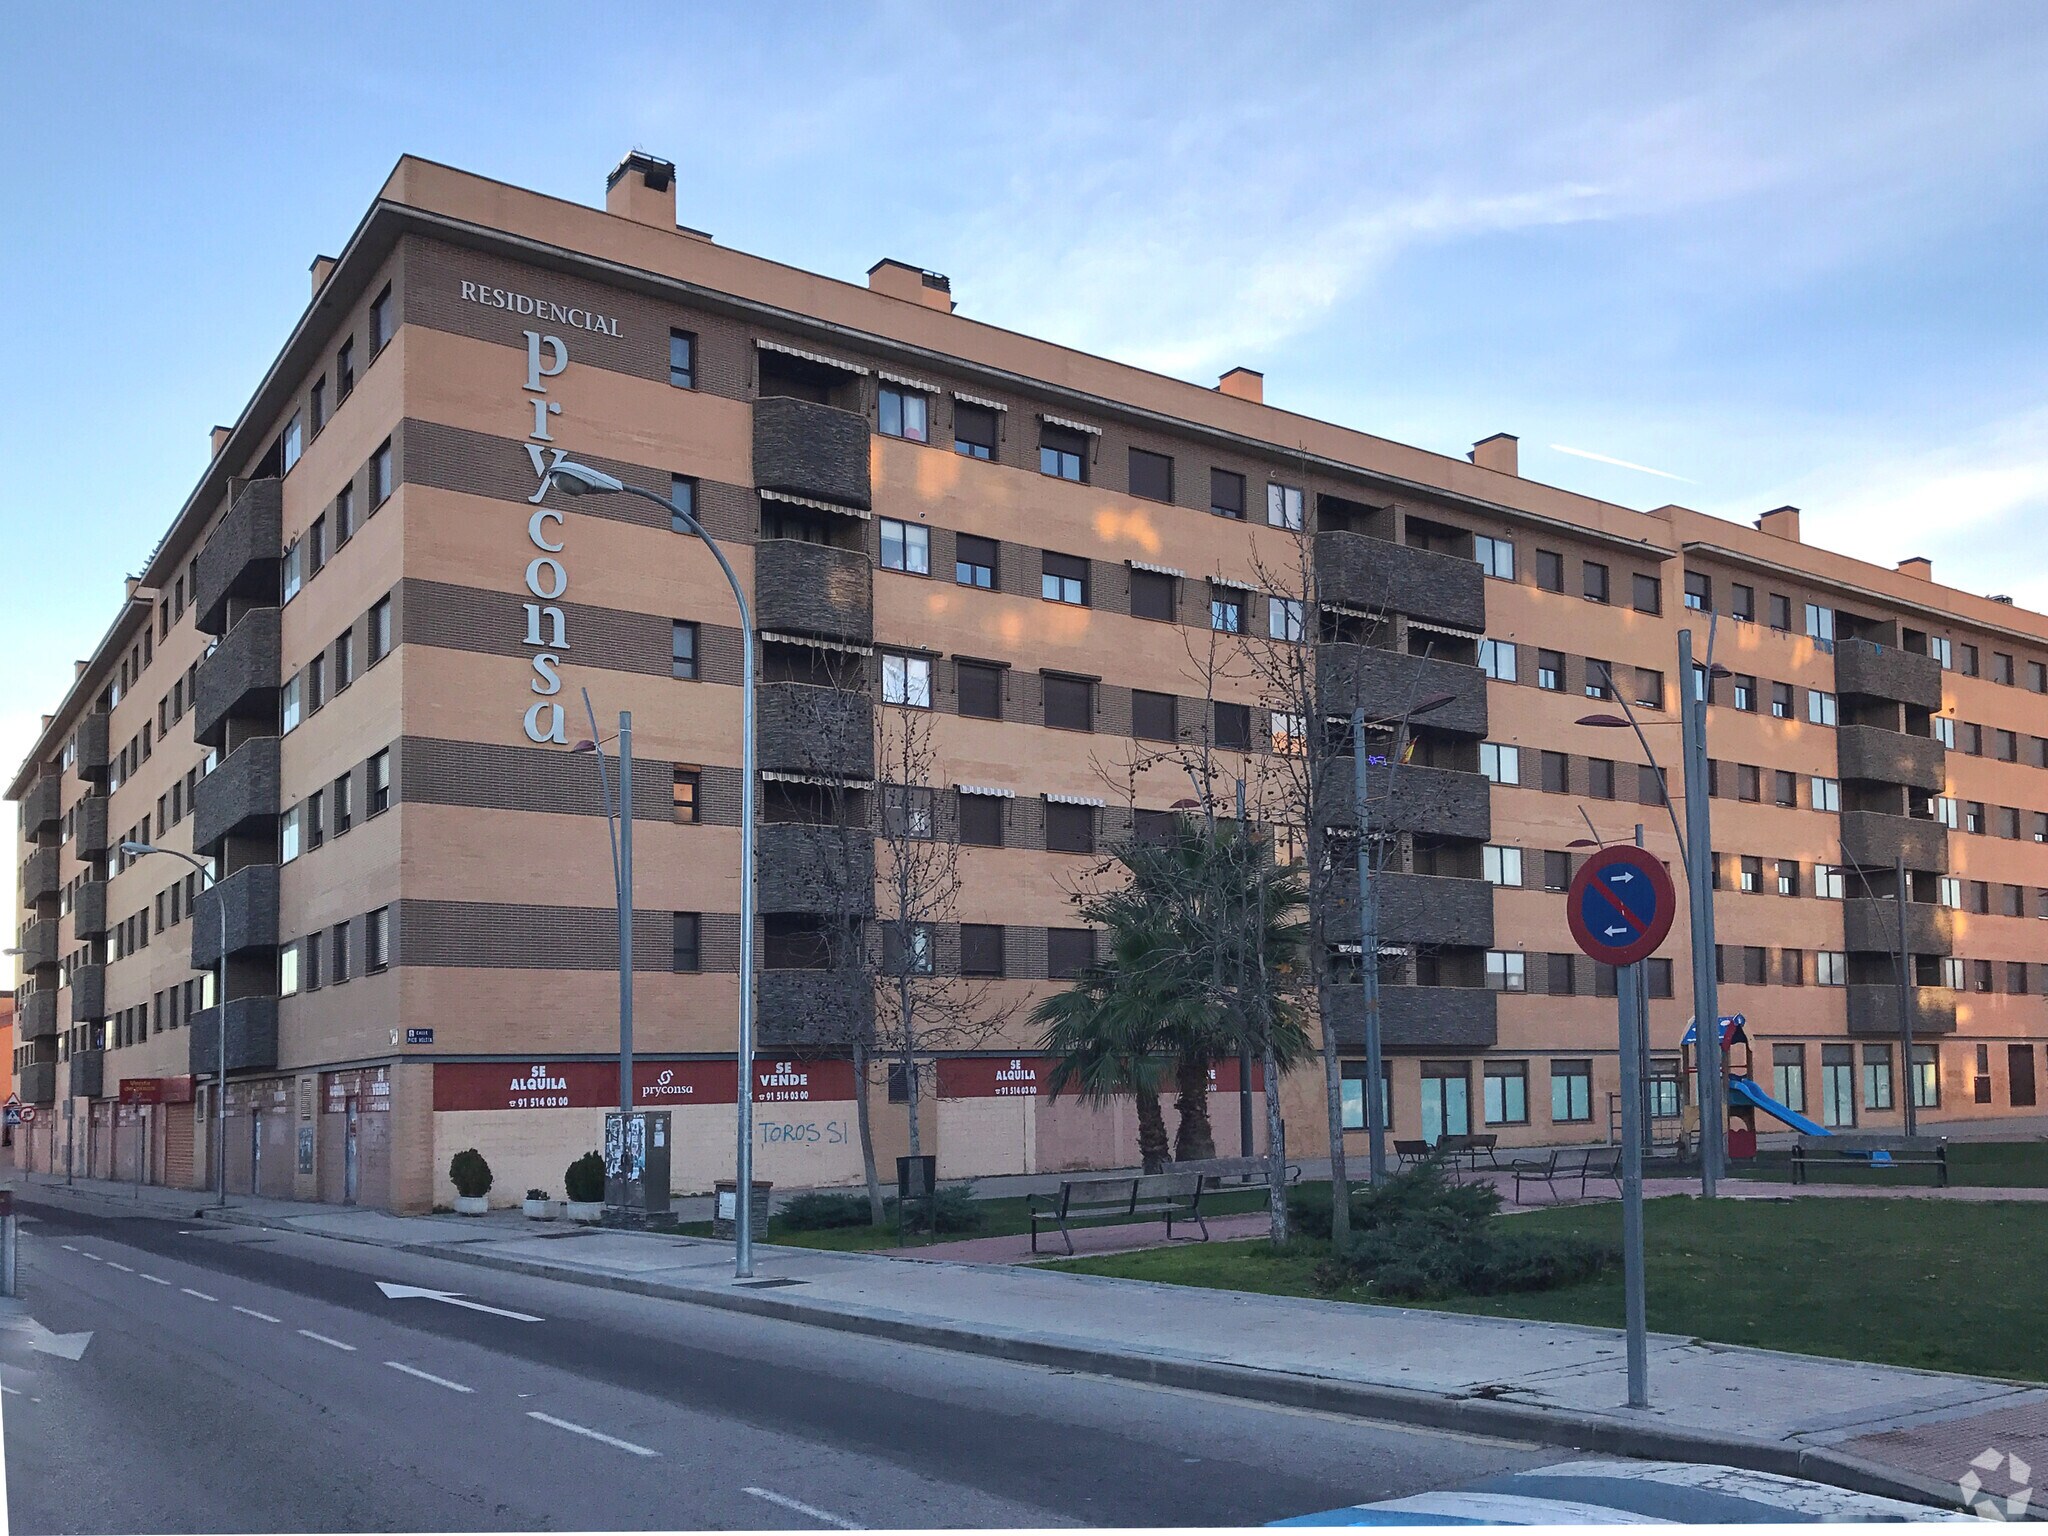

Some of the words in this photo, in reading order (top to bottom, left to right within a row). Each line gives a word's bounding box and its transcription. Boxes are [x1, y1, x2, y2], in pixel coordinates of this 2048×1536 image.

[460, 280, 624, 338] RESIDENCIAL
[522, 329, 571, 745] pryconsa
[775, 1062, 792, 1074] SE
[1010, 1059, 1021, 1070] SE
[531, 1065, 546, 1078] SE
[995, 1070, 1036, 1081] ALQUILA
[510, 1077, 567, 1091] ALQUILA
[759, 1074, 808, 1087] VENDE
[642, 1085, 693, 1098] pryconsa
[766, 1092, 774, 1101] 91
[776, 1092, 789, 1101] 514
[790, 1091, 799, 1100] 03
[800, 1091, 809, 1100] 00
[1001, 1086, 1008, 1095] 91
[1010, 1086, 1020, 1094] 514
[1021, 1086, 1029, 1094] 03
[517, 1098, 527, 1108] 91
[530, 1097, 545, 1107] 514
[546, 1096, 557, 1107] 03
[558, 1096, 569, 1106] 00
[758, 1122, 821, 1143] TOROS
[826, 1121, 848, 1144] SI
